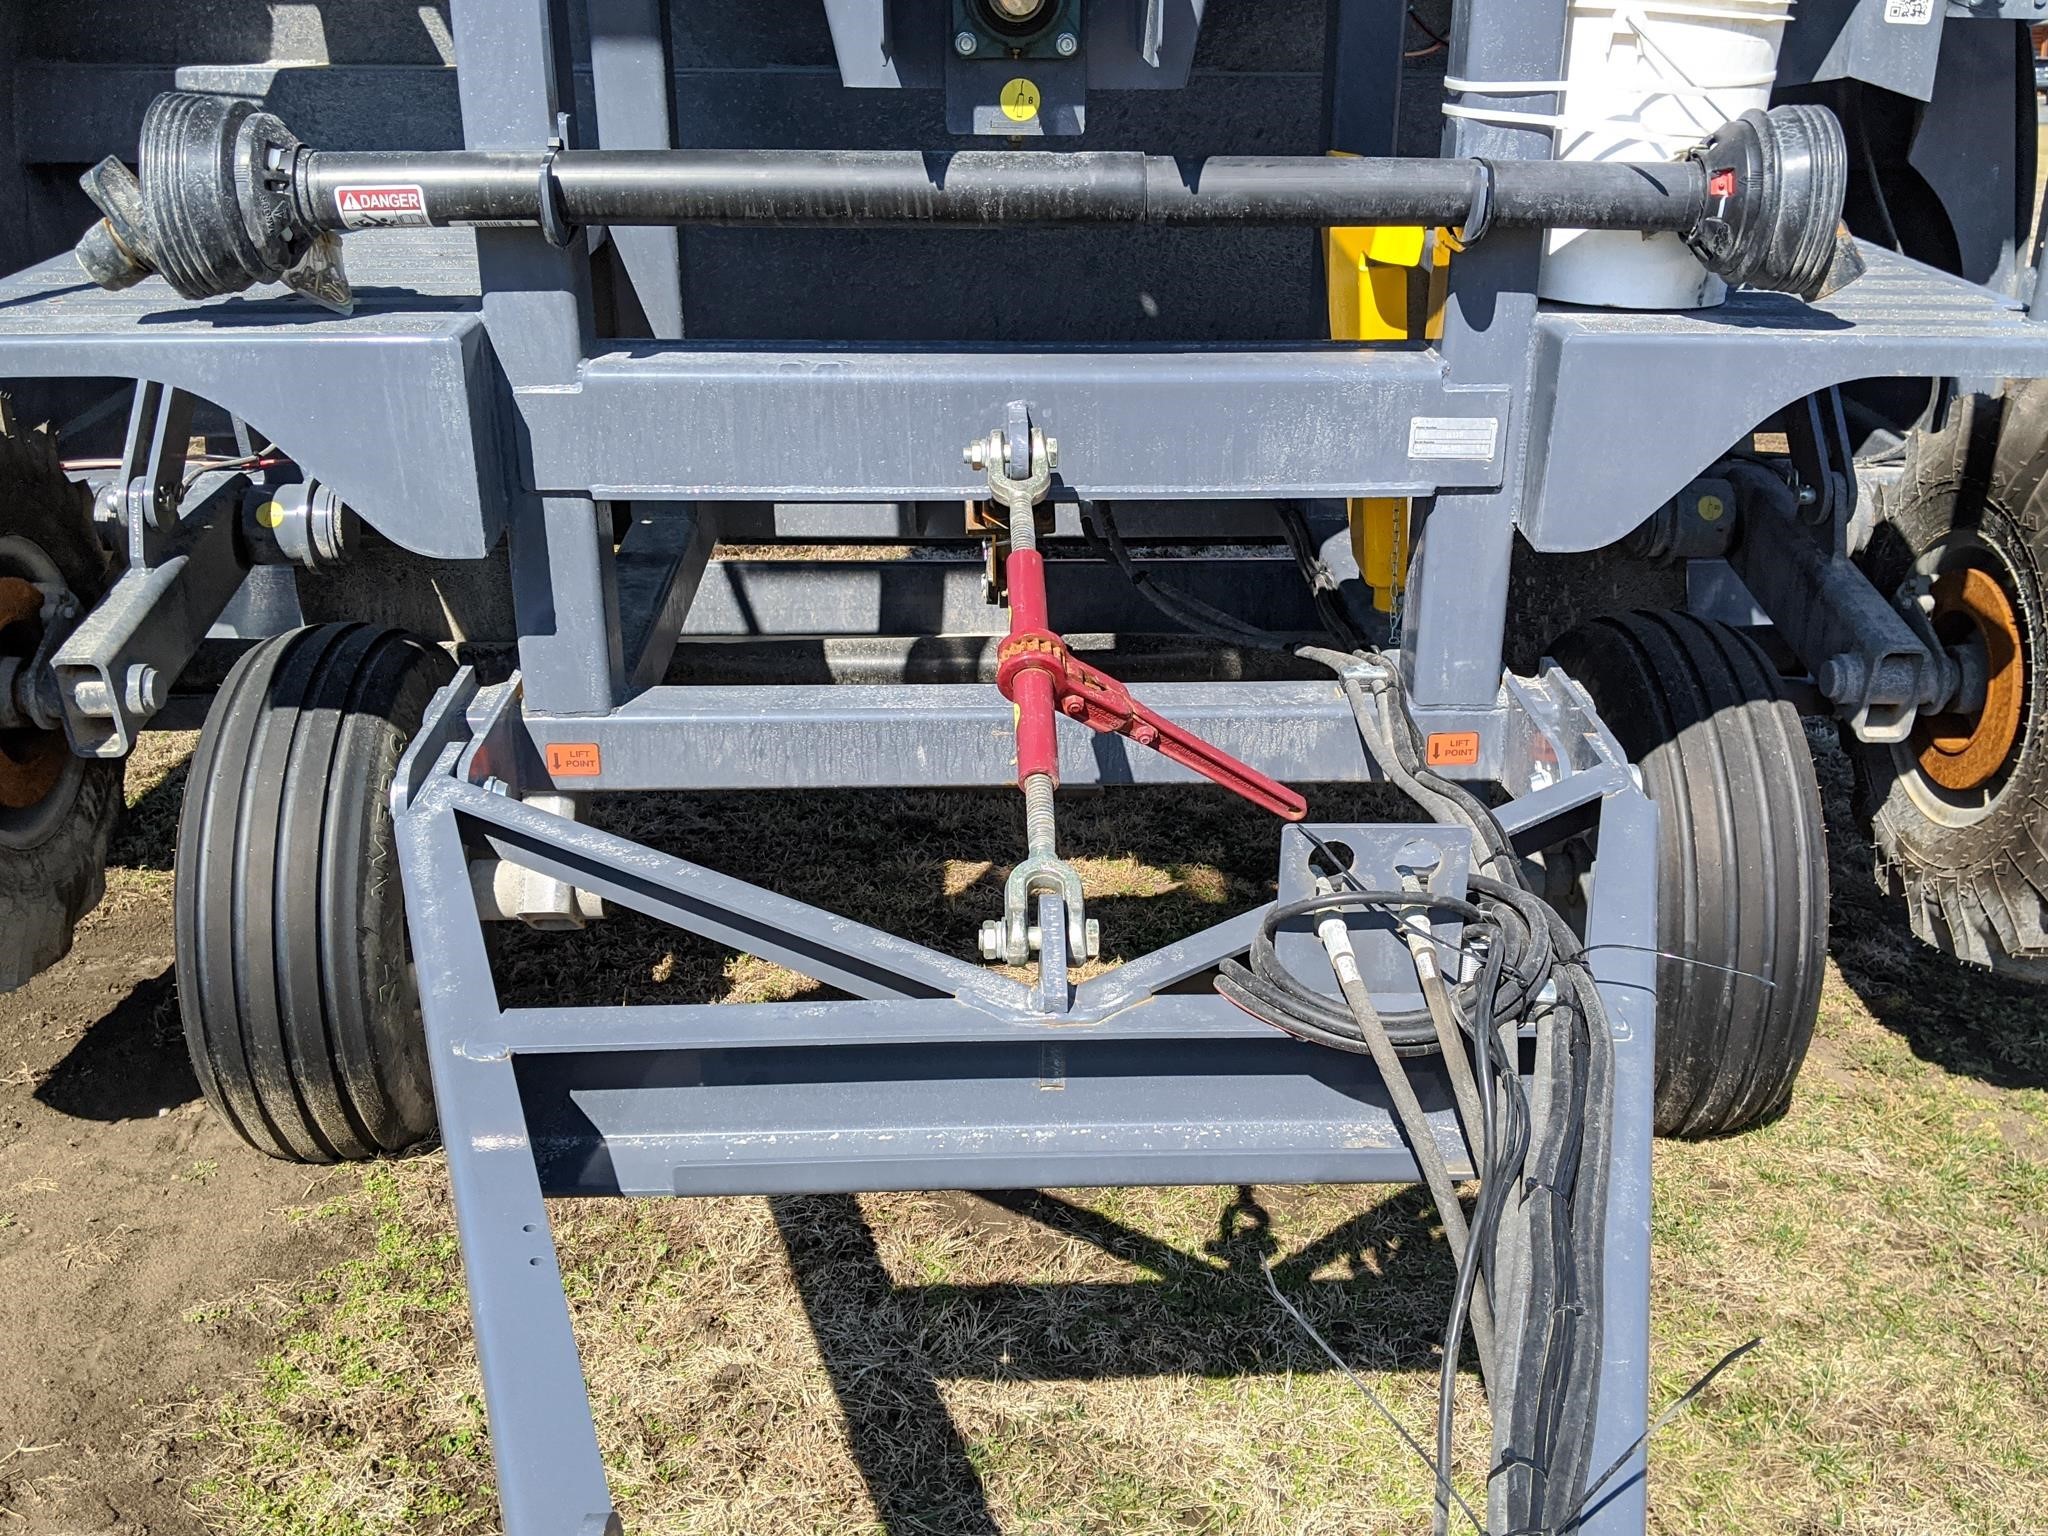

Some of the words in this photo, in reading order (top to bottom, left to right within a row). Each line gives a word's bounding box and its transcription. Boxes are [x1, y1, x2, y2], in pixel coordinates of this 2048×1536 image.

[360, 193, 419, 209] DANGER
[1450, 739, 1471, 747] LIFT
[569, 750, 591, 758] LIFT
[1444, 748, 1474, 757] POINT
[565, 760, 596, 768] POINT
